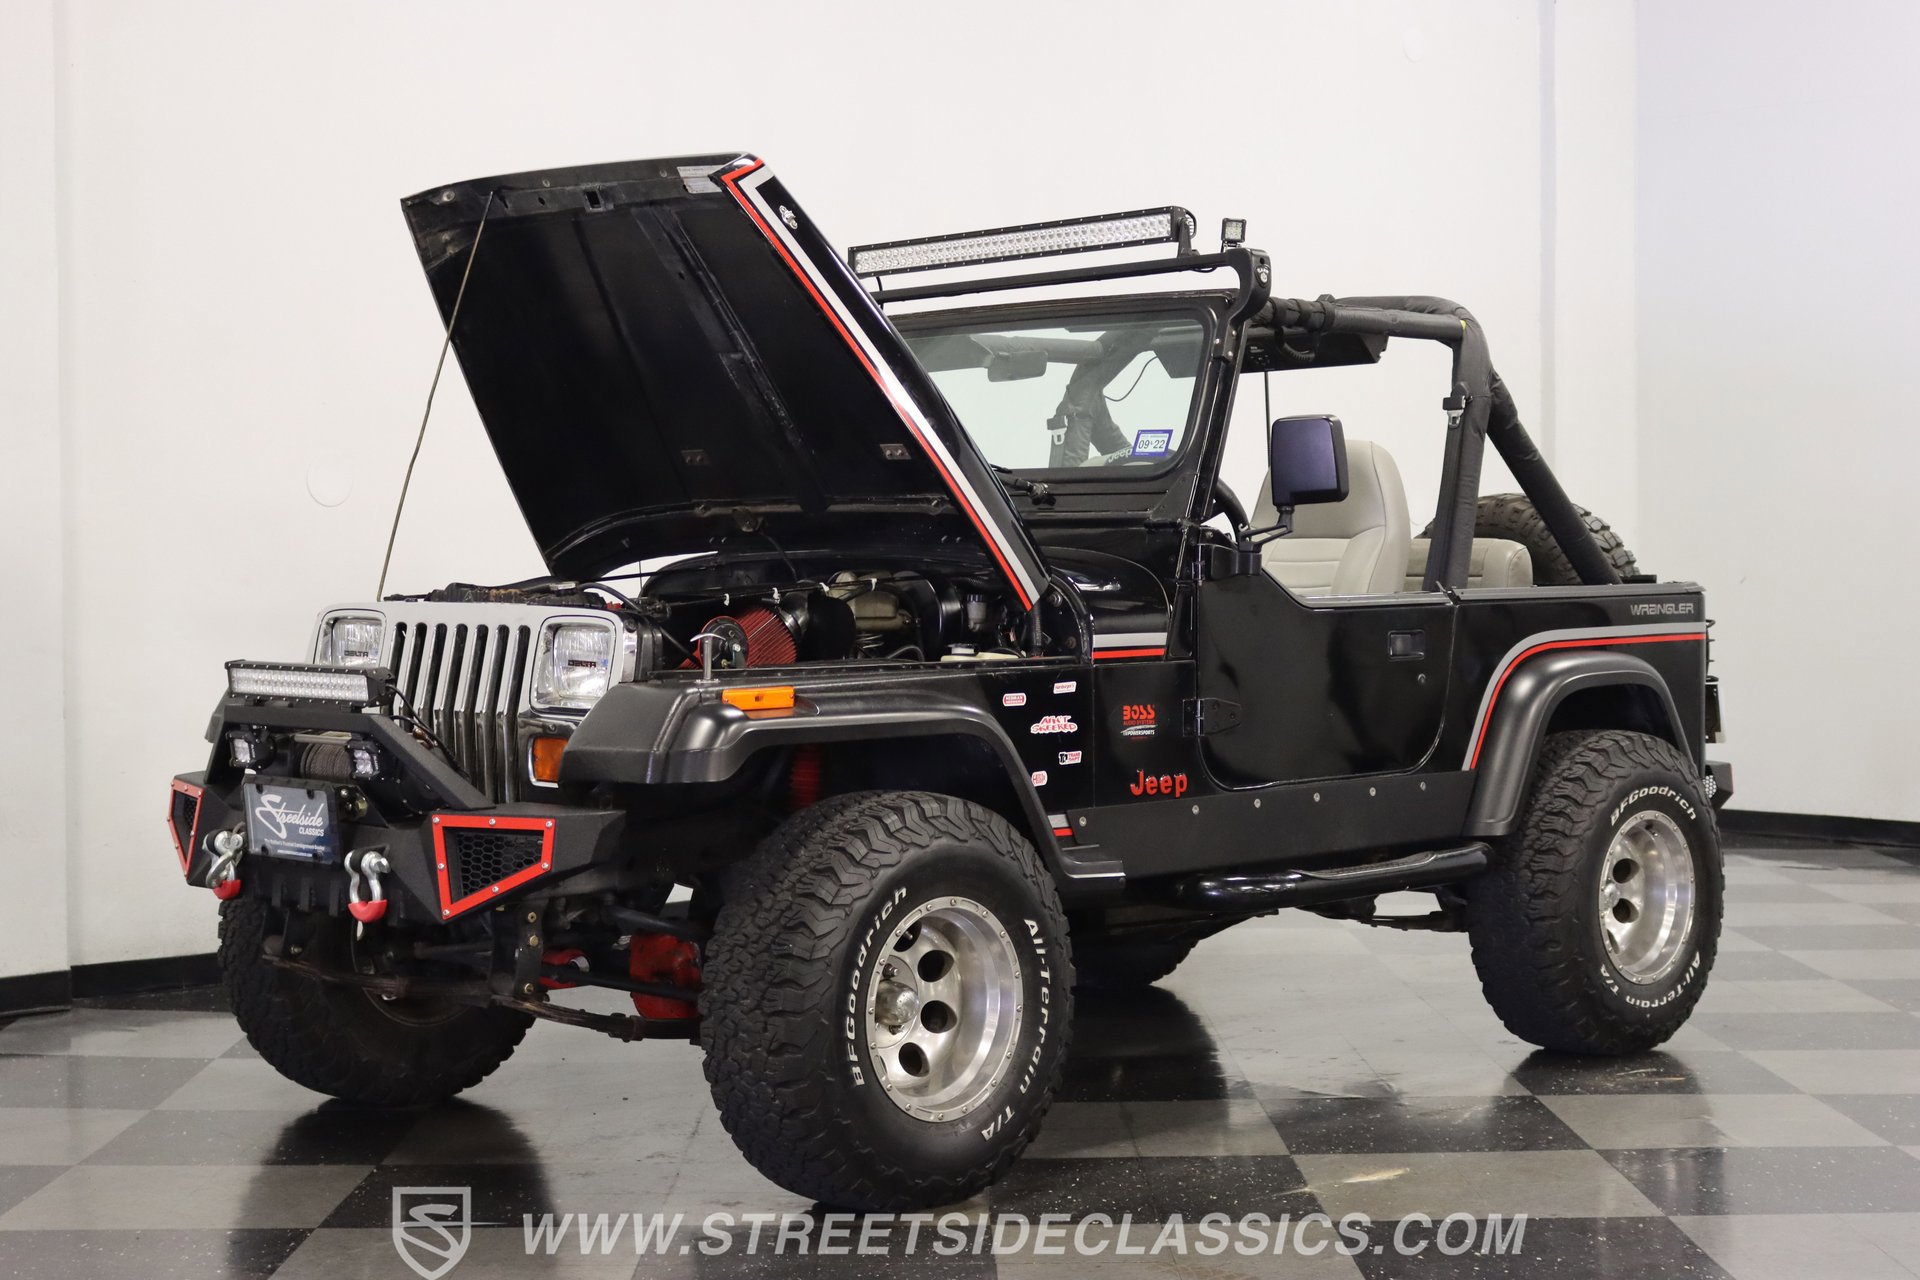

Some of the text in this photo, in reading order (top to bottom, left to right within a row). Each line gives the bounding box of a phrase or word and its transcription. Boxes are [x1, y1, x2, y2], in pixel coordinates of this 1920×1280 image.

[1138, 439, 1166, 450] 09 22
[1107, 446, 1133, 463] Jeep
[1630, 603, 1694, 616] WRANGLER
[344, 650, 368, 658] DELTA
[567, 659, 597, 668] DELTA
[1123, 704, 1156, 720] BOSS
[1130, 769, 1188, 798] Jeep
[1610, 785, 1697, 827] BFGoodrich
[255, 794, 324, 839] Streetside
[298, 826, 325, 837] CLASSICS
[846, 886, 907, 1087] BFGoodrich
[1600, 951, 1700, 1009] All-Terrain T/A
[980, 918, 1051, 1142] All-Terrain T/A
